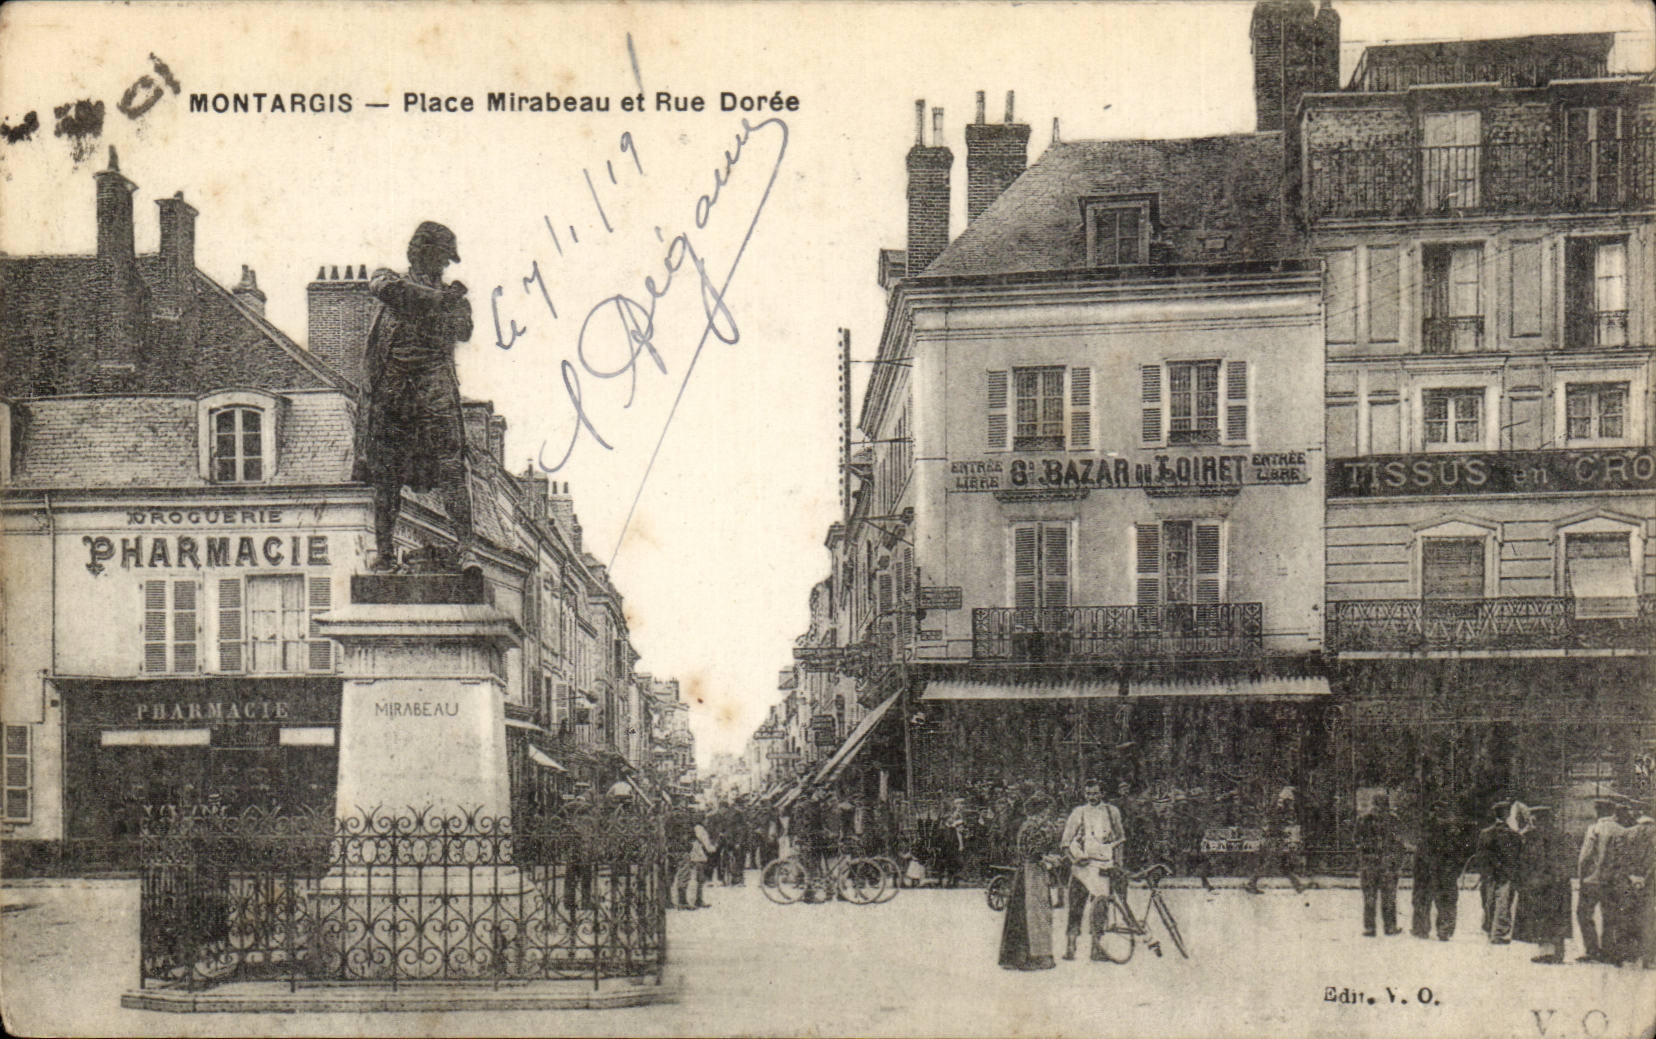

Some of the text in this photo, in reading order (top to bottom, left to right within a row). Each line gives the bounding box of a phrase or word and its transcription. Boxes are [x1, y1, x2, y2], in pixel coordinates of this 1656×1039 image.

[1038, 458, 1130, 488] BAZAR
[1154, 455, 1248, 485] LOIRET
[1344, 459, 1488, 488] TISSUS
[1512, 467, 1549, 485] en
[126, 510, 284, 525] DROGUERIE
[82, 534, 332, 577] PHARMACIE
[138, 701, 290, 720] PHARMACIE
[375, 702, 459, 717] MIRABEAU
